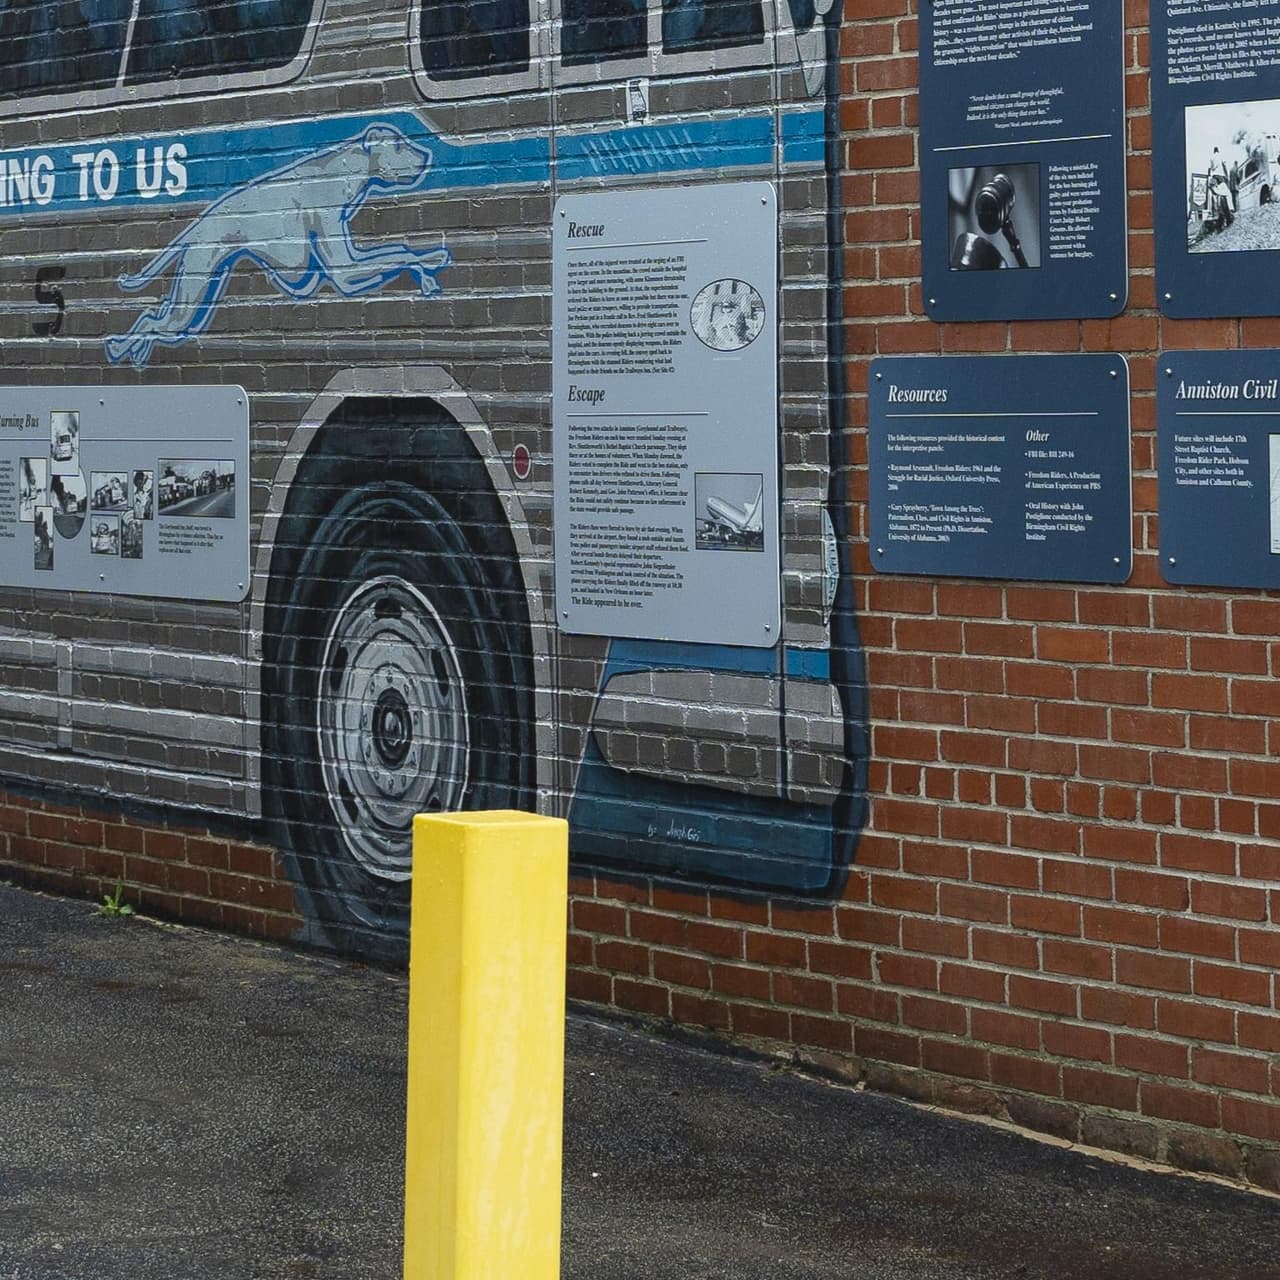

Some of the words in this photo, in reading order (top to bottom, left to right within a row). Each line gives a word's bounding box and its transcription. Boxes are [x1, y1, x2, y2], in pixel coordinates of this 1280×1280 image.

[71, 148, 119, 201] TO
[136, 142, 188, 197] US
[567, 221, 605, 238] Rescue
[568, 385, 605, 405] Escape
[888, 385, 947, 402] Resources
[1176, 380, 1238, 398] Anniston
[1243, 379, 1277, 398] Civil
[25, 413, 39, 427] Bus
[1025, 429, 1050, 442] Other
[572, 596, 581, 604] The
[582, 597, 593, 605] Ride
[594, 599, 616, 607] appeared
[623, 599, 629, 607] be
